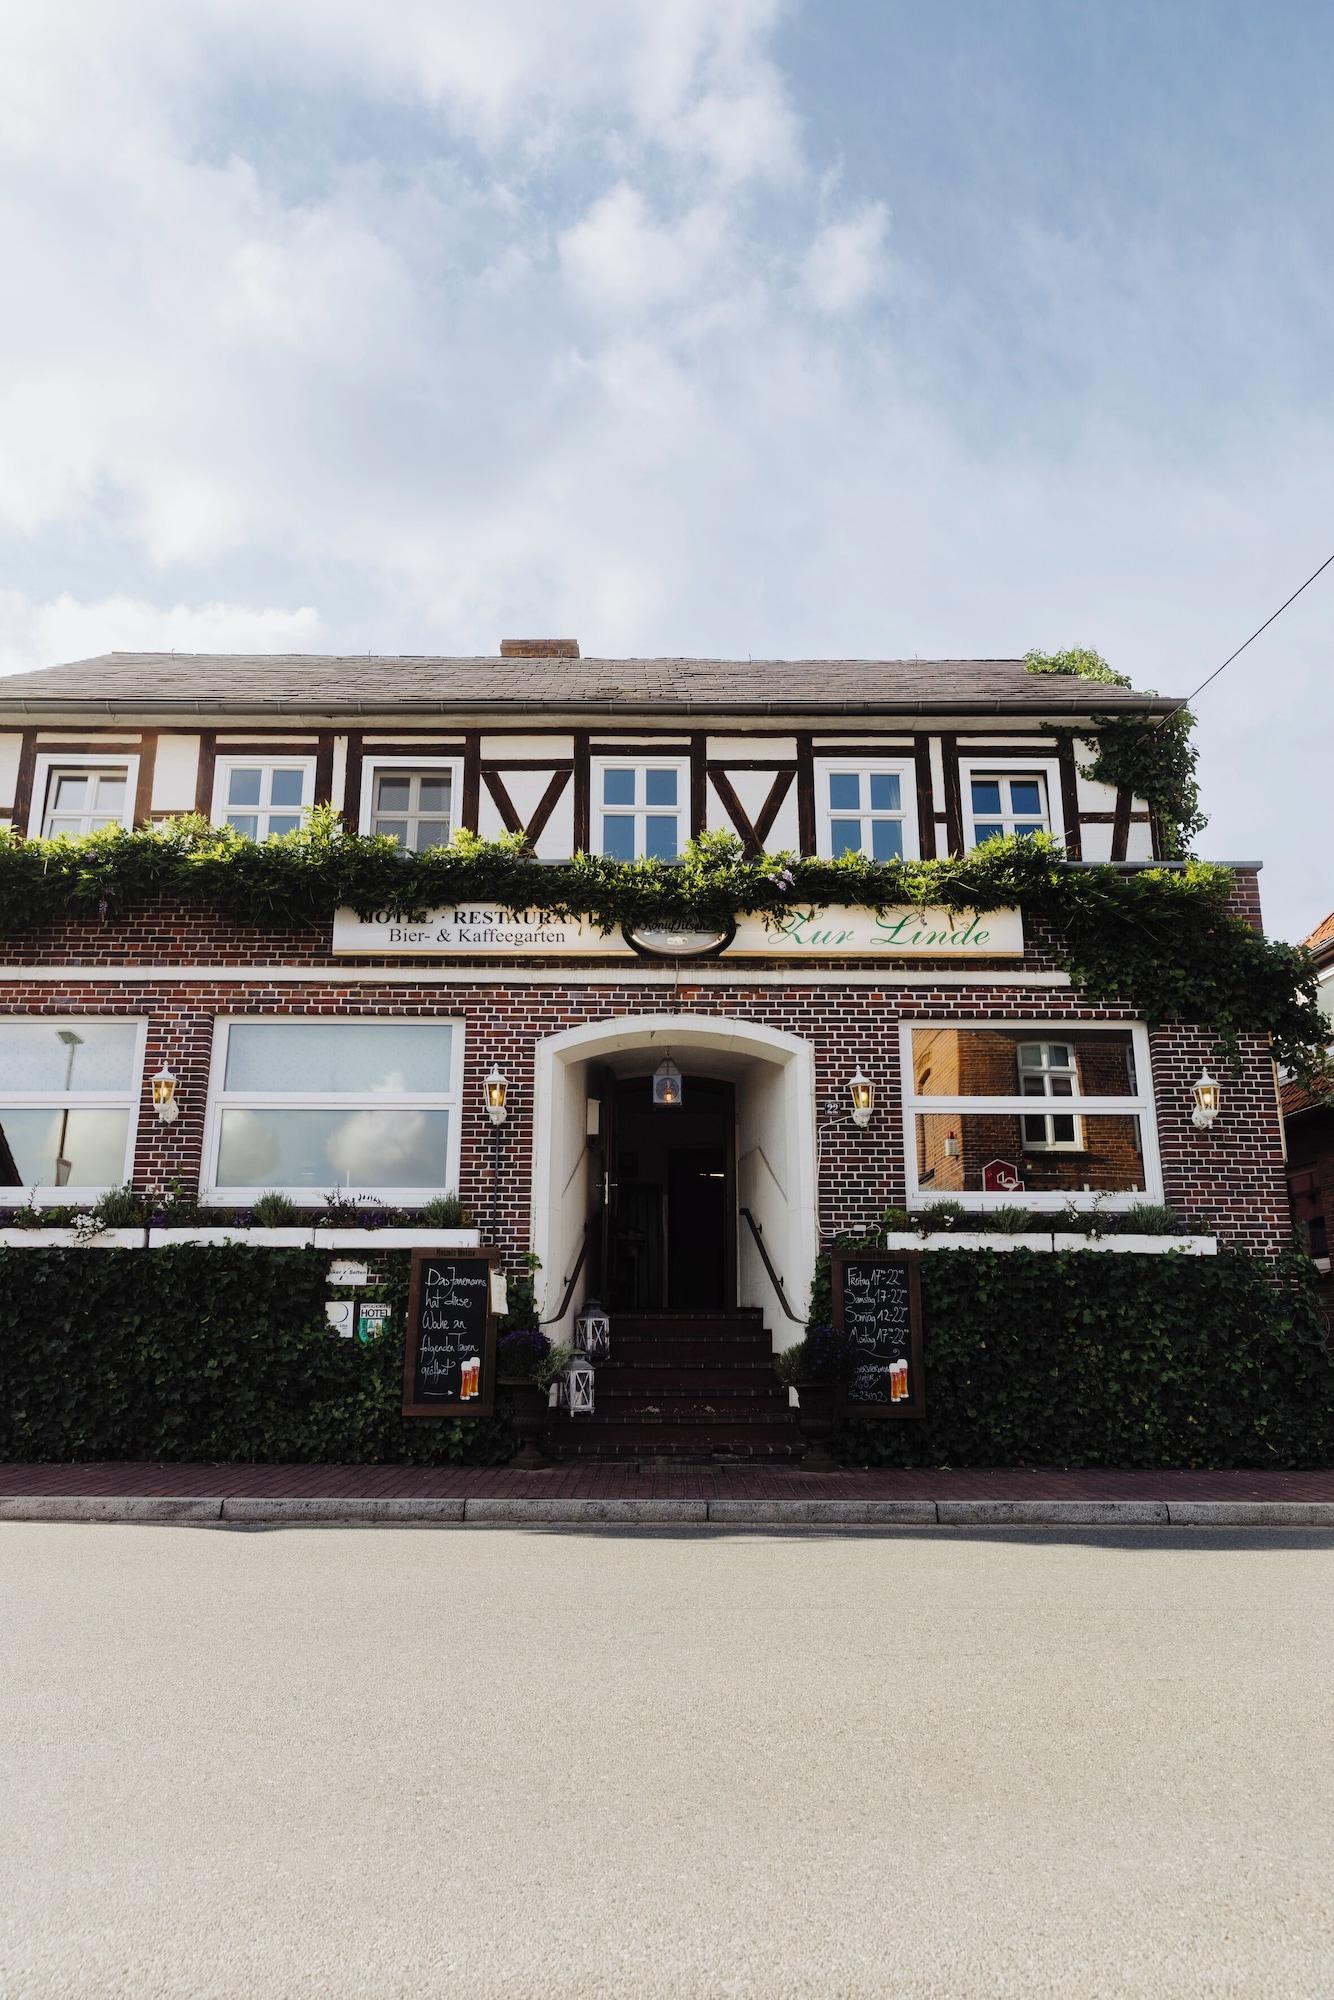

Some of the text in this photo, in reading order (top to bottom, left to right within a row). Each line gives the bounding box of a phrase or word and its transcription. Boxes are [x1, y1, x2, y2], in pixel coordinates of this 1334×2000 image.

[454, 911, 598, 924] RESTAURANT
[389, 928, 565, 946] Bier- & Kaffeegarten
[768, 911, 992, 945] Zur Linde
[827, 1103, 838, 1114] 22
[425, 1267, 450, 1287] Das
[848, 1267, 870, 1295] Freitag
[426, 1288, 442, 1308] hat
[844, 1287, 877, 1310] Samstag
[361, 1309, 391, 1318] HOTEL
[453, 1318, 467, 1329] an
[849, 1326, 876, 1351] Montag
